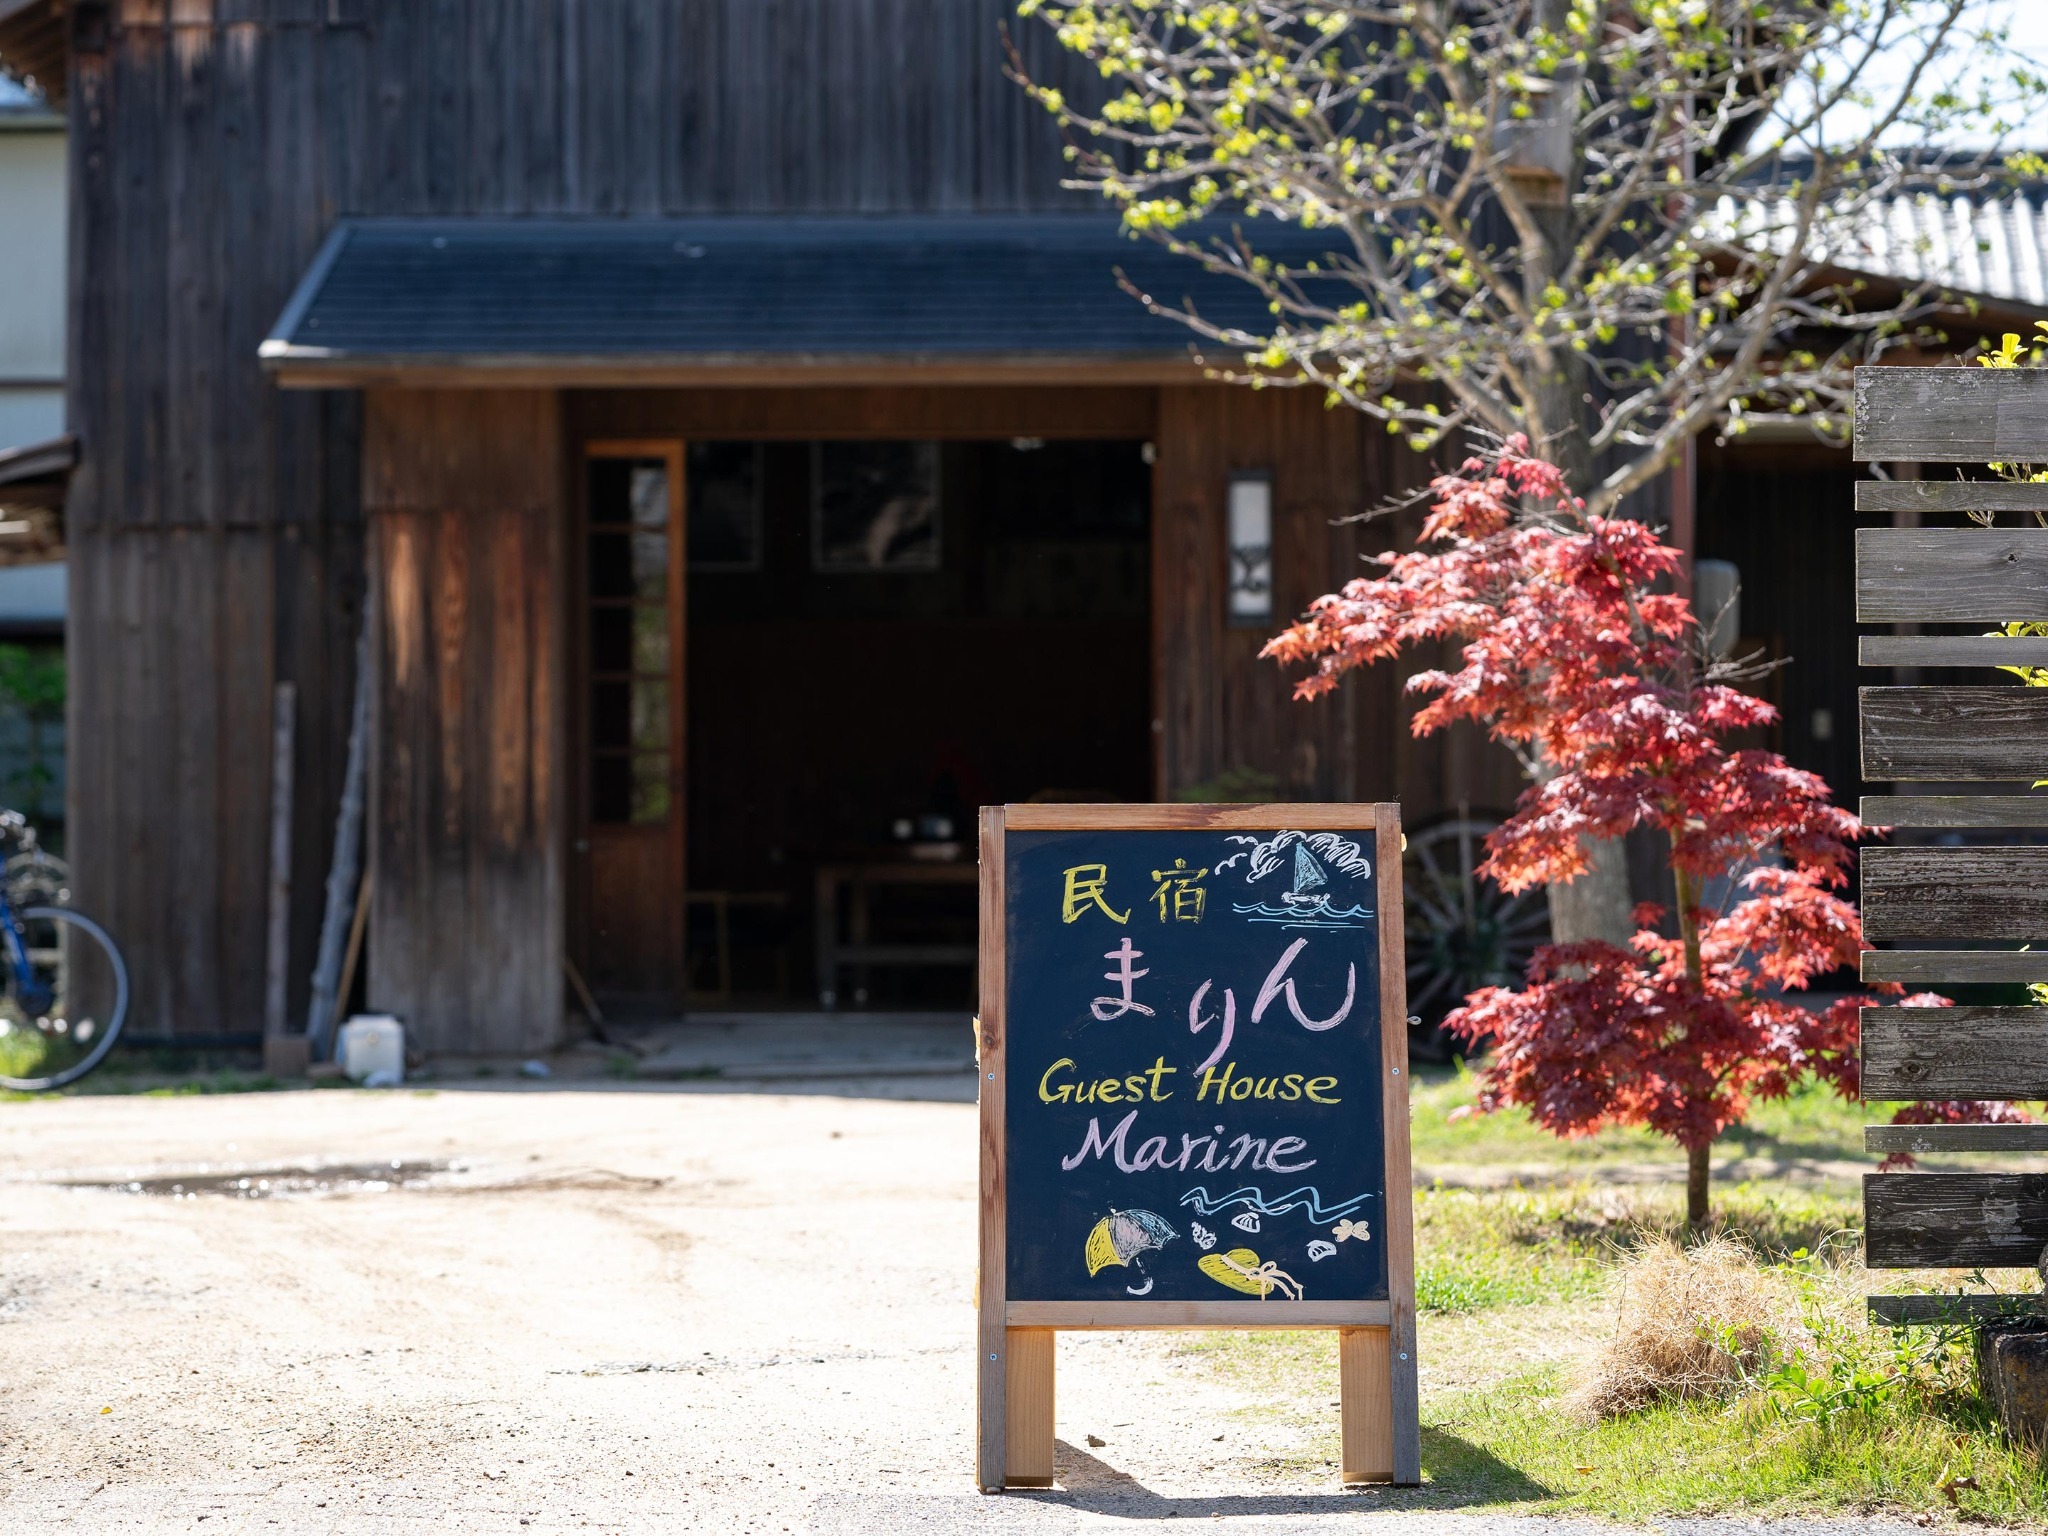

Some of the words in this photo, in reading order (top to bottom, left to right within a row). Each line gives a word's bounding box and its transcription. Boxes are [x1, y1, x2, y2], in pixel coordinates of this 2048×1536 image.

[1062, 858, 1208, 924] 民宿
[1090, 937, 1356, 1077] まりん
[1038, 1056, 1177, 1103] Guest
[1196, 1062, 1341, 1104] House
[1062, 1110, 1317, 1173] Marine
